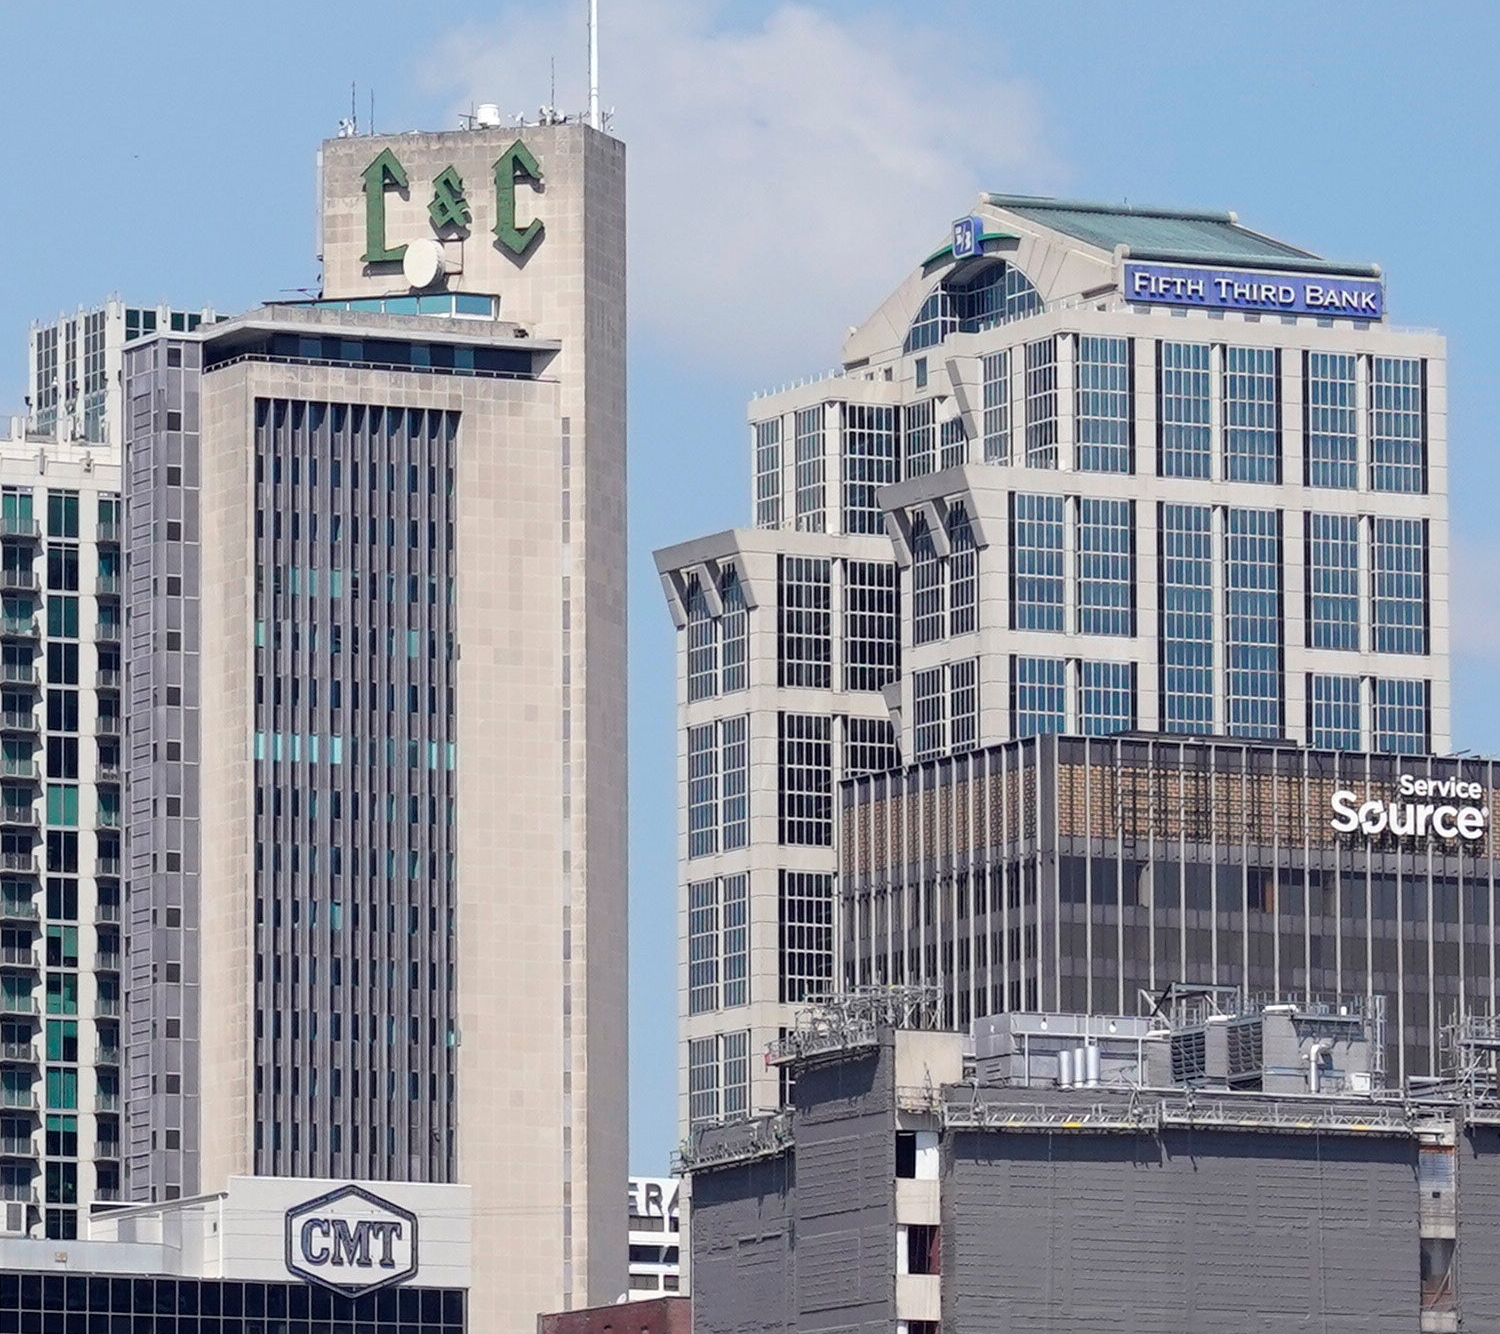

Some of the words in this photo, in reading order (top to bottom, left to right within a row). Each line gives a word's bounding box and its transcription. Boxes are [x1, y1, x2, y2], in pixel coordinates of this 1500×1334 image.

[1400, 774, 1482, 799] Service
[1331, 790, 1485, 839] Source
[301, 1218, 402, 1269] CMT
